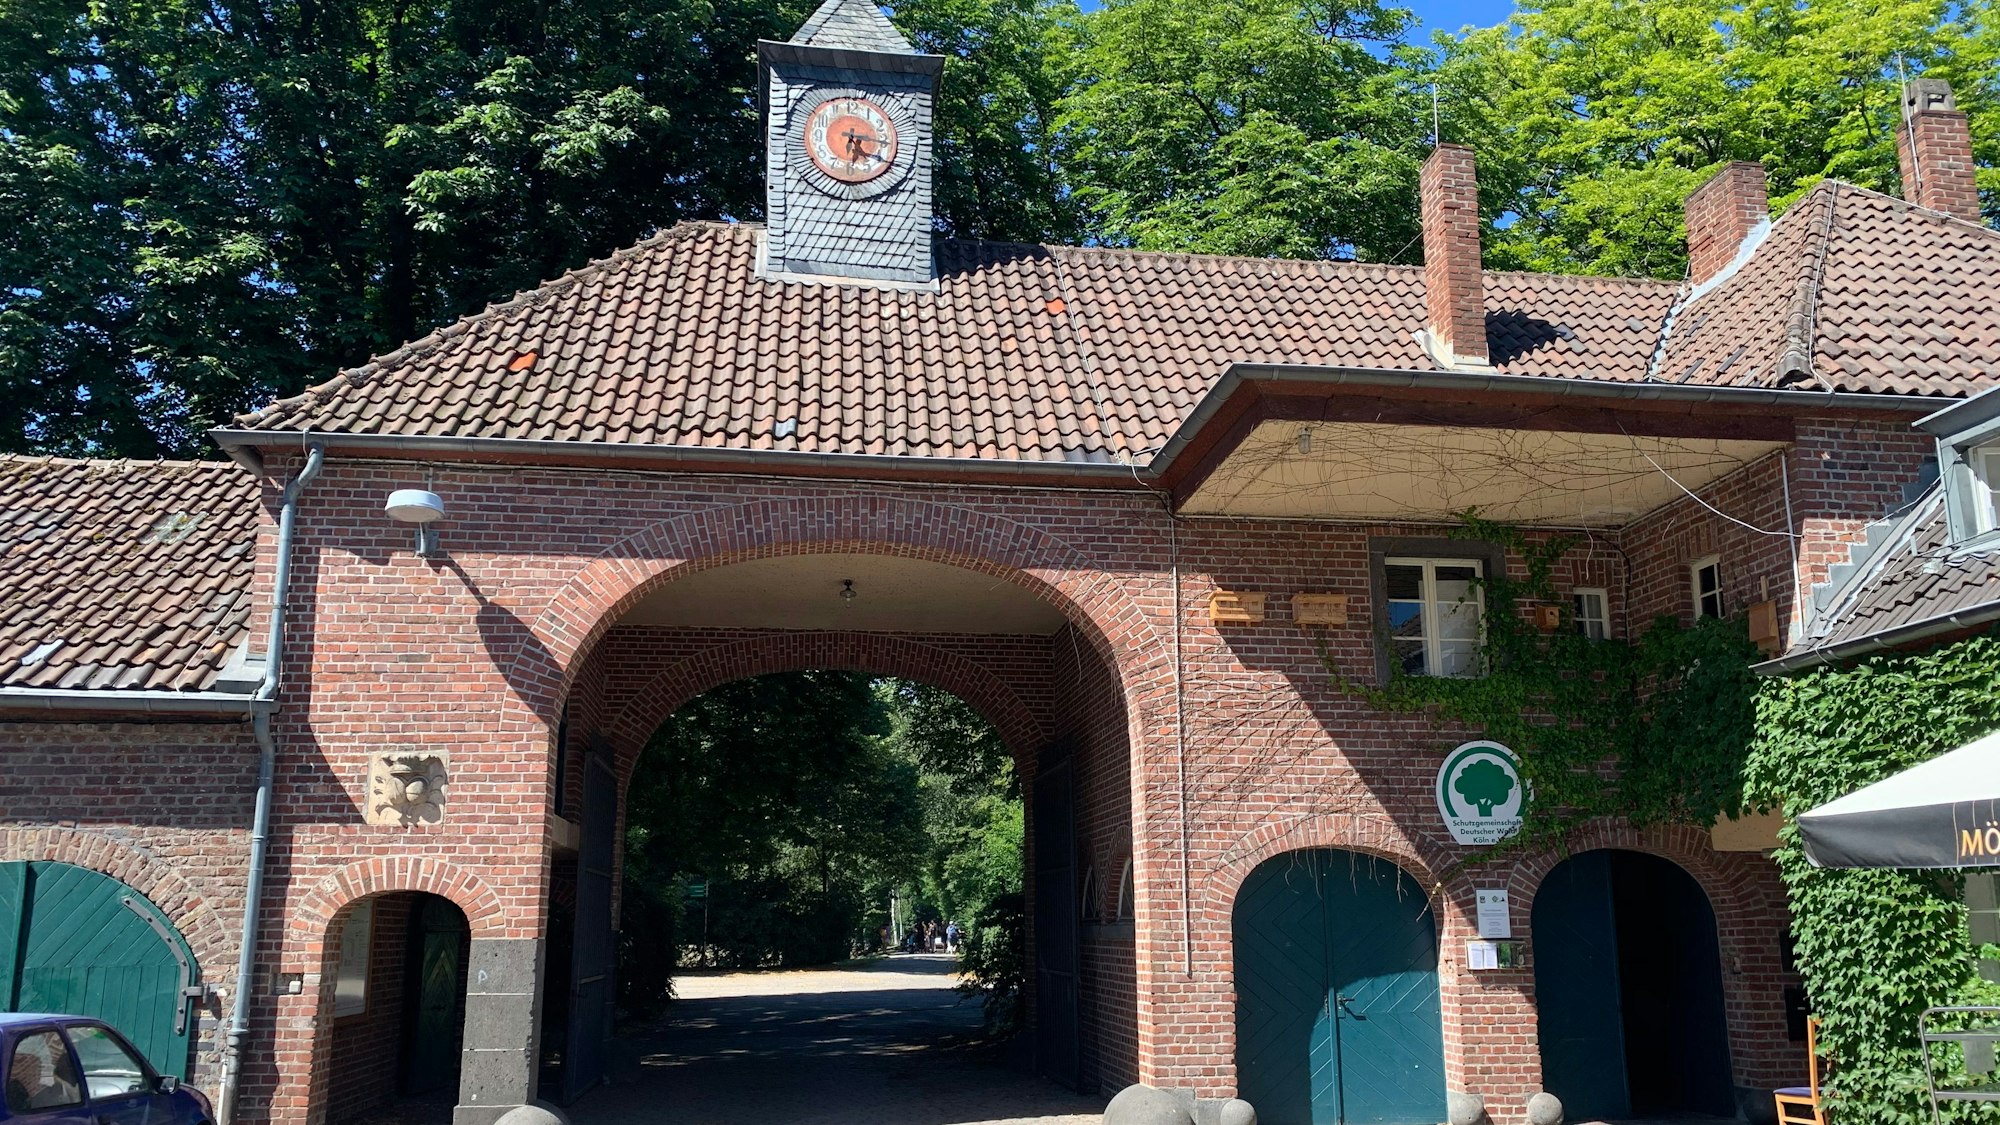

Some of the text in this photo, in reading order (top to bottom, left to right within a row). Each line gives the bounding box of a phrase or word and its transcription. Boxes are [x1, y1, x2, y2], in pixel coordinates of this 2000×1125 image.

[847, 101, 858, 115] 12
[818, 114, 828, 128] 10
[876, 119, 883, 133] 2
[815, 128, 822, 142] 9
[818, 144, 827, 159] 8
[830, 156, 838, 169] 7
[847, 161, 855, 176] 6
[1460, 827, 1495, 835] Deutscher
[1473, 836, 1490, 844] Köln
[1961, 820, 2000, 857] MÖ
